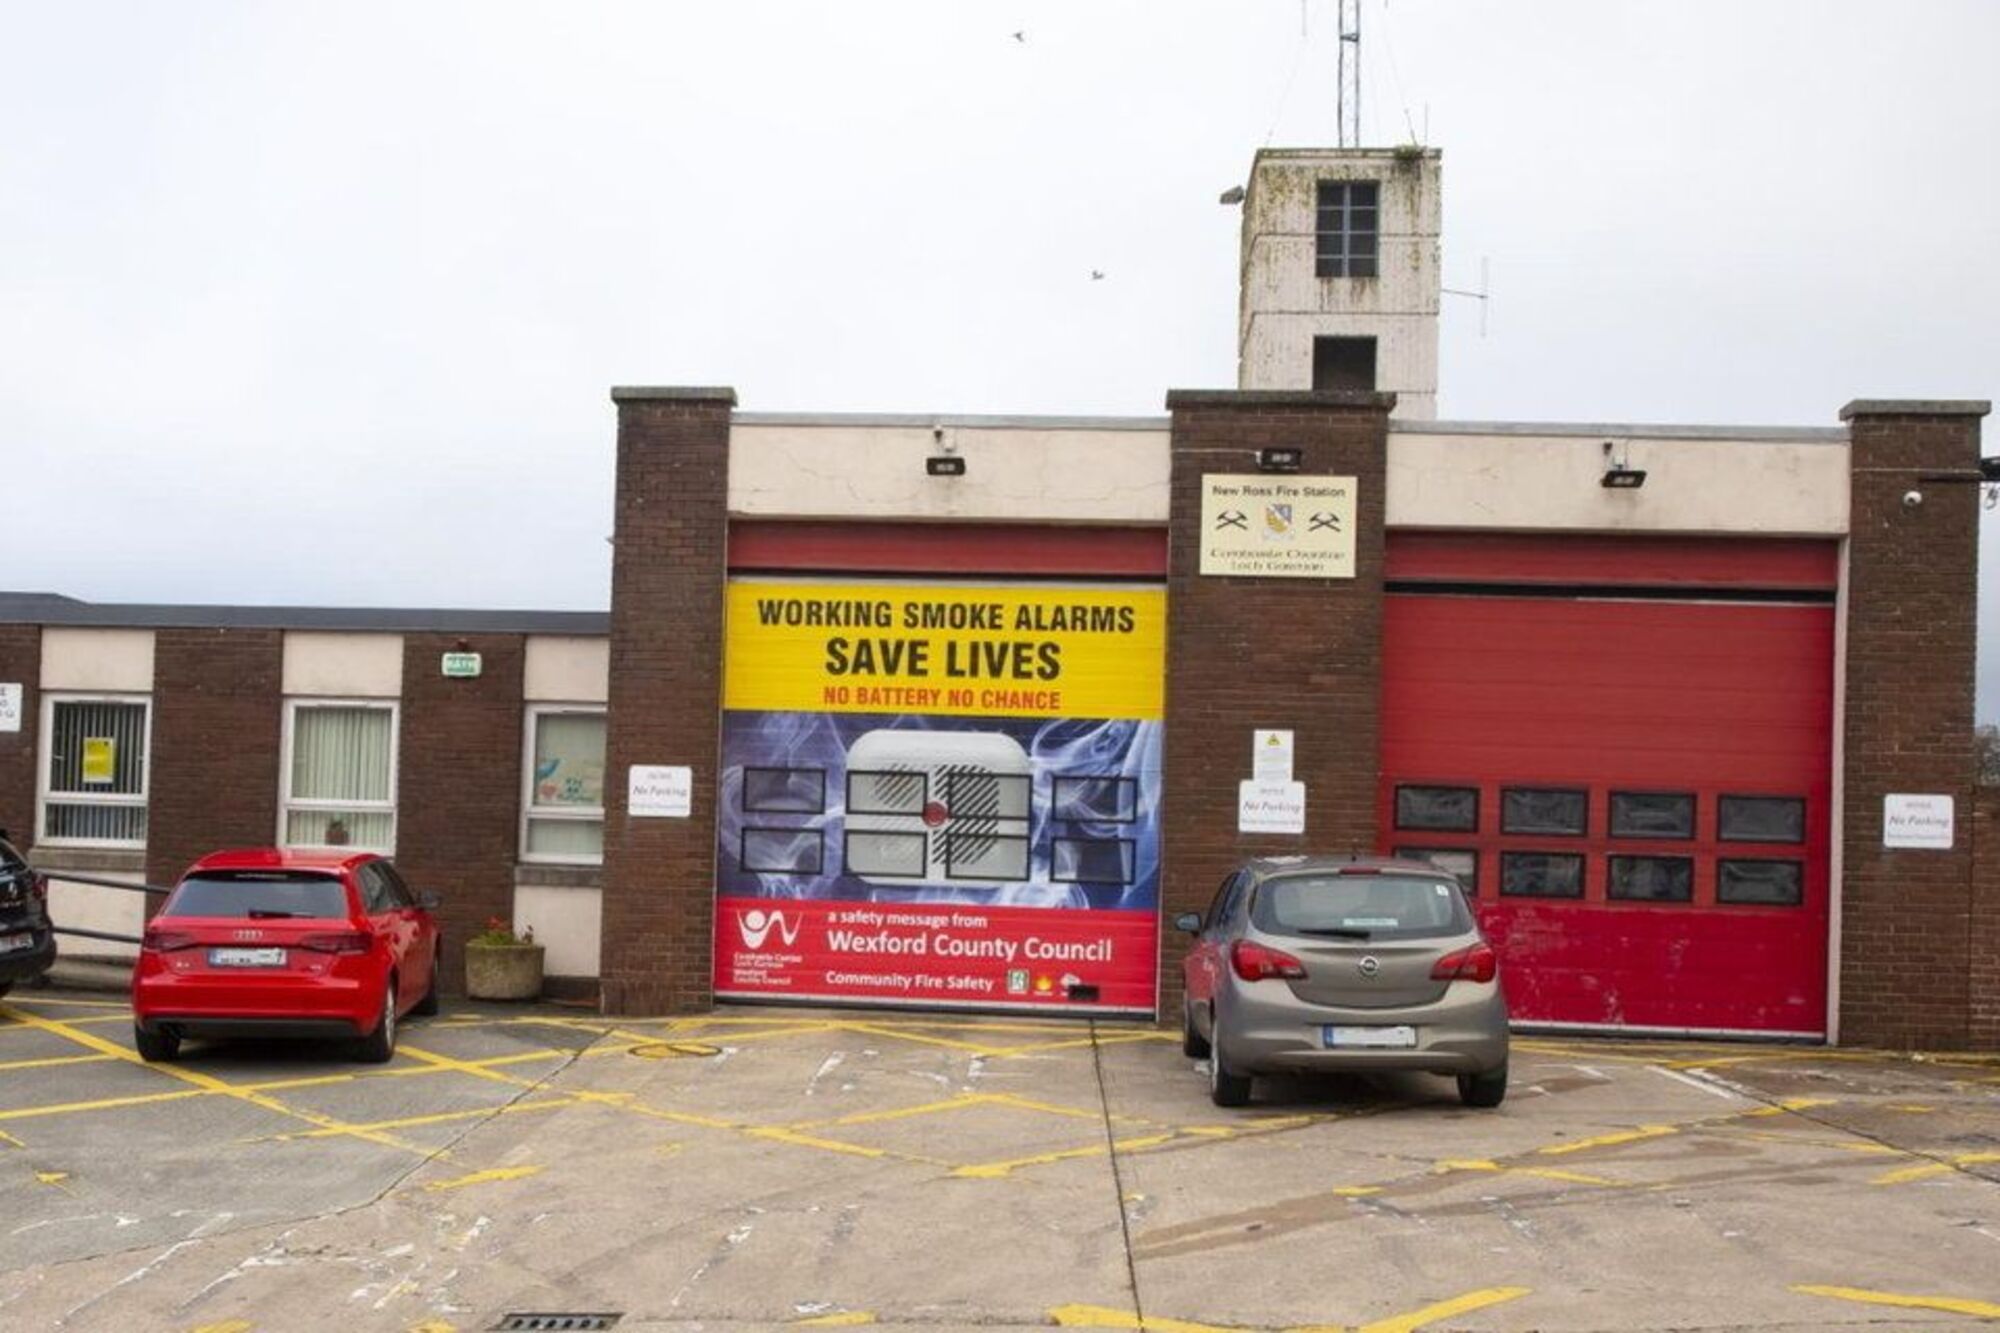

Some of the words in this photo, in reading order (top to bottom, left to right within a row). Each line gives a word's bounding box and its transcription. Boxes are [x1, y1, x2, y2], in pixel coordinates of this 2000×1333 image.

[1212, 485, 1239, 496] New
[1242, 485, 1272, 496] Ross
[1276, 485, 1299, 496] Fire
[1303, 486, 1346, 497] Station
[758, 599, 892, 627] WORKING
[903, 602, 1003, 630] SMOKE
[1015, 604, 1134, 633] ALARMS
[825, 637, 929, 676] SAVE
[946, 640, 1061, 680] LIVES
[824, 686, 849, 705] NO
[857, 687, 941, 707] BATTERY
[947, 689, 973, 707] NO
[981, 690, 1060, 709] CHANCE
[827, 911, 837, 923] a
[841, 910, 883, 928] safety
[886, 913, 950, 929] message
[952, 913, 988, 928] from
[827, 930, 927, 954] Wexford
[934, 934, 1018, 962] County
[1024, 937, 1112, 961] Council
[825, 971, 912, 990] Community
[915, 974, 943, 988] Fire
[947, 975, 994, 992] Safety
